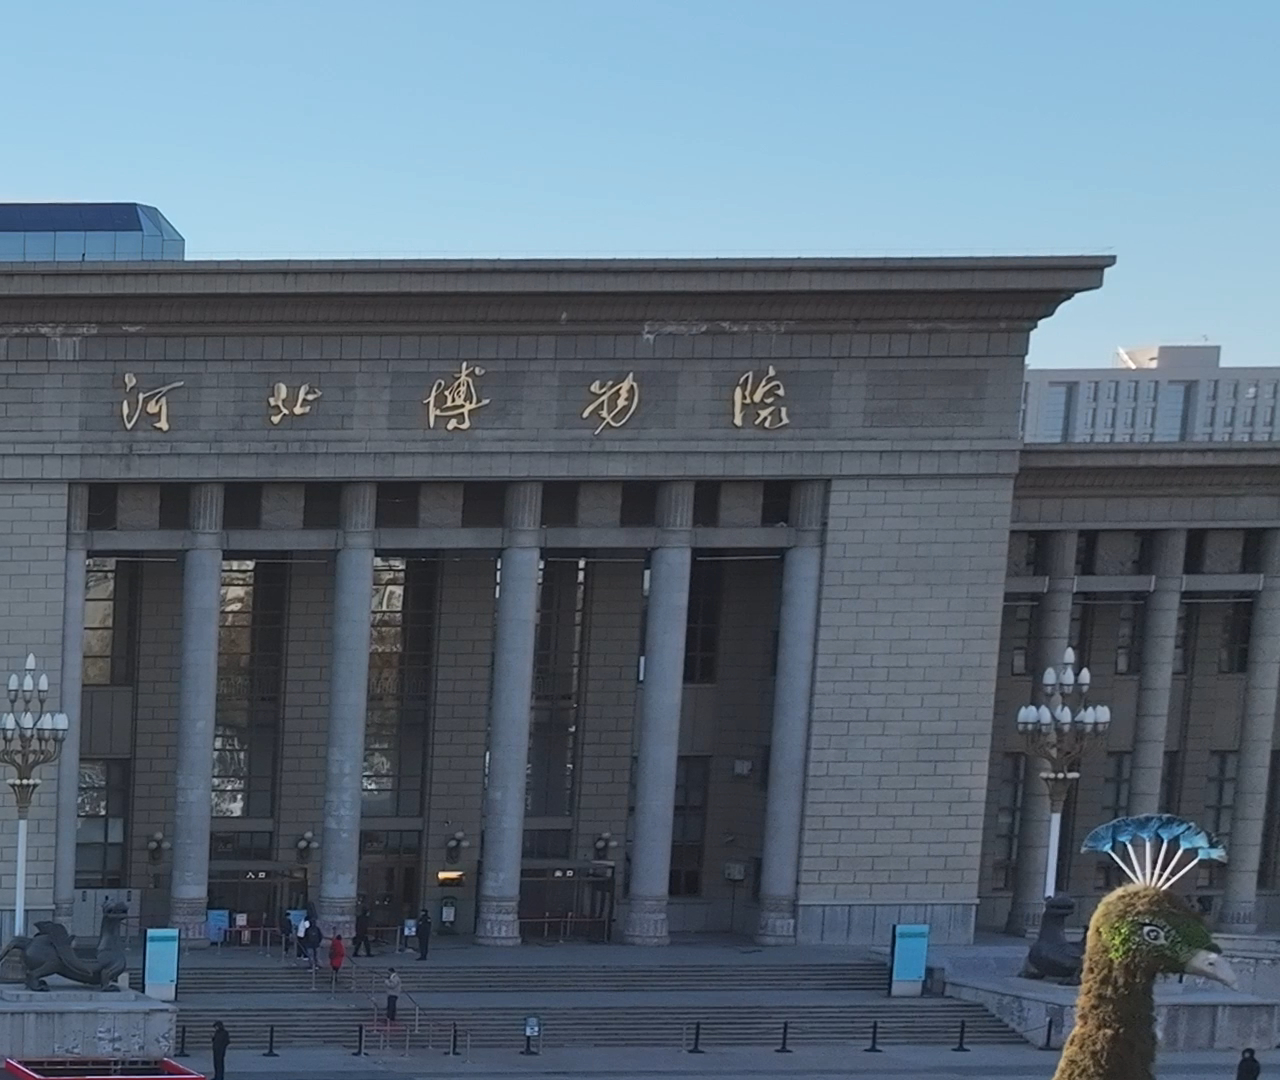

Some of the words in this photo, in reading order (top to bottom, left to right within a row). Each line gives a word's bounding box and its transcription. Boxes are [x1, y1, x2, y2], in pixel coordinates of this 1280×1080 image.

[121, 361, 791, 435] 河北博物院
